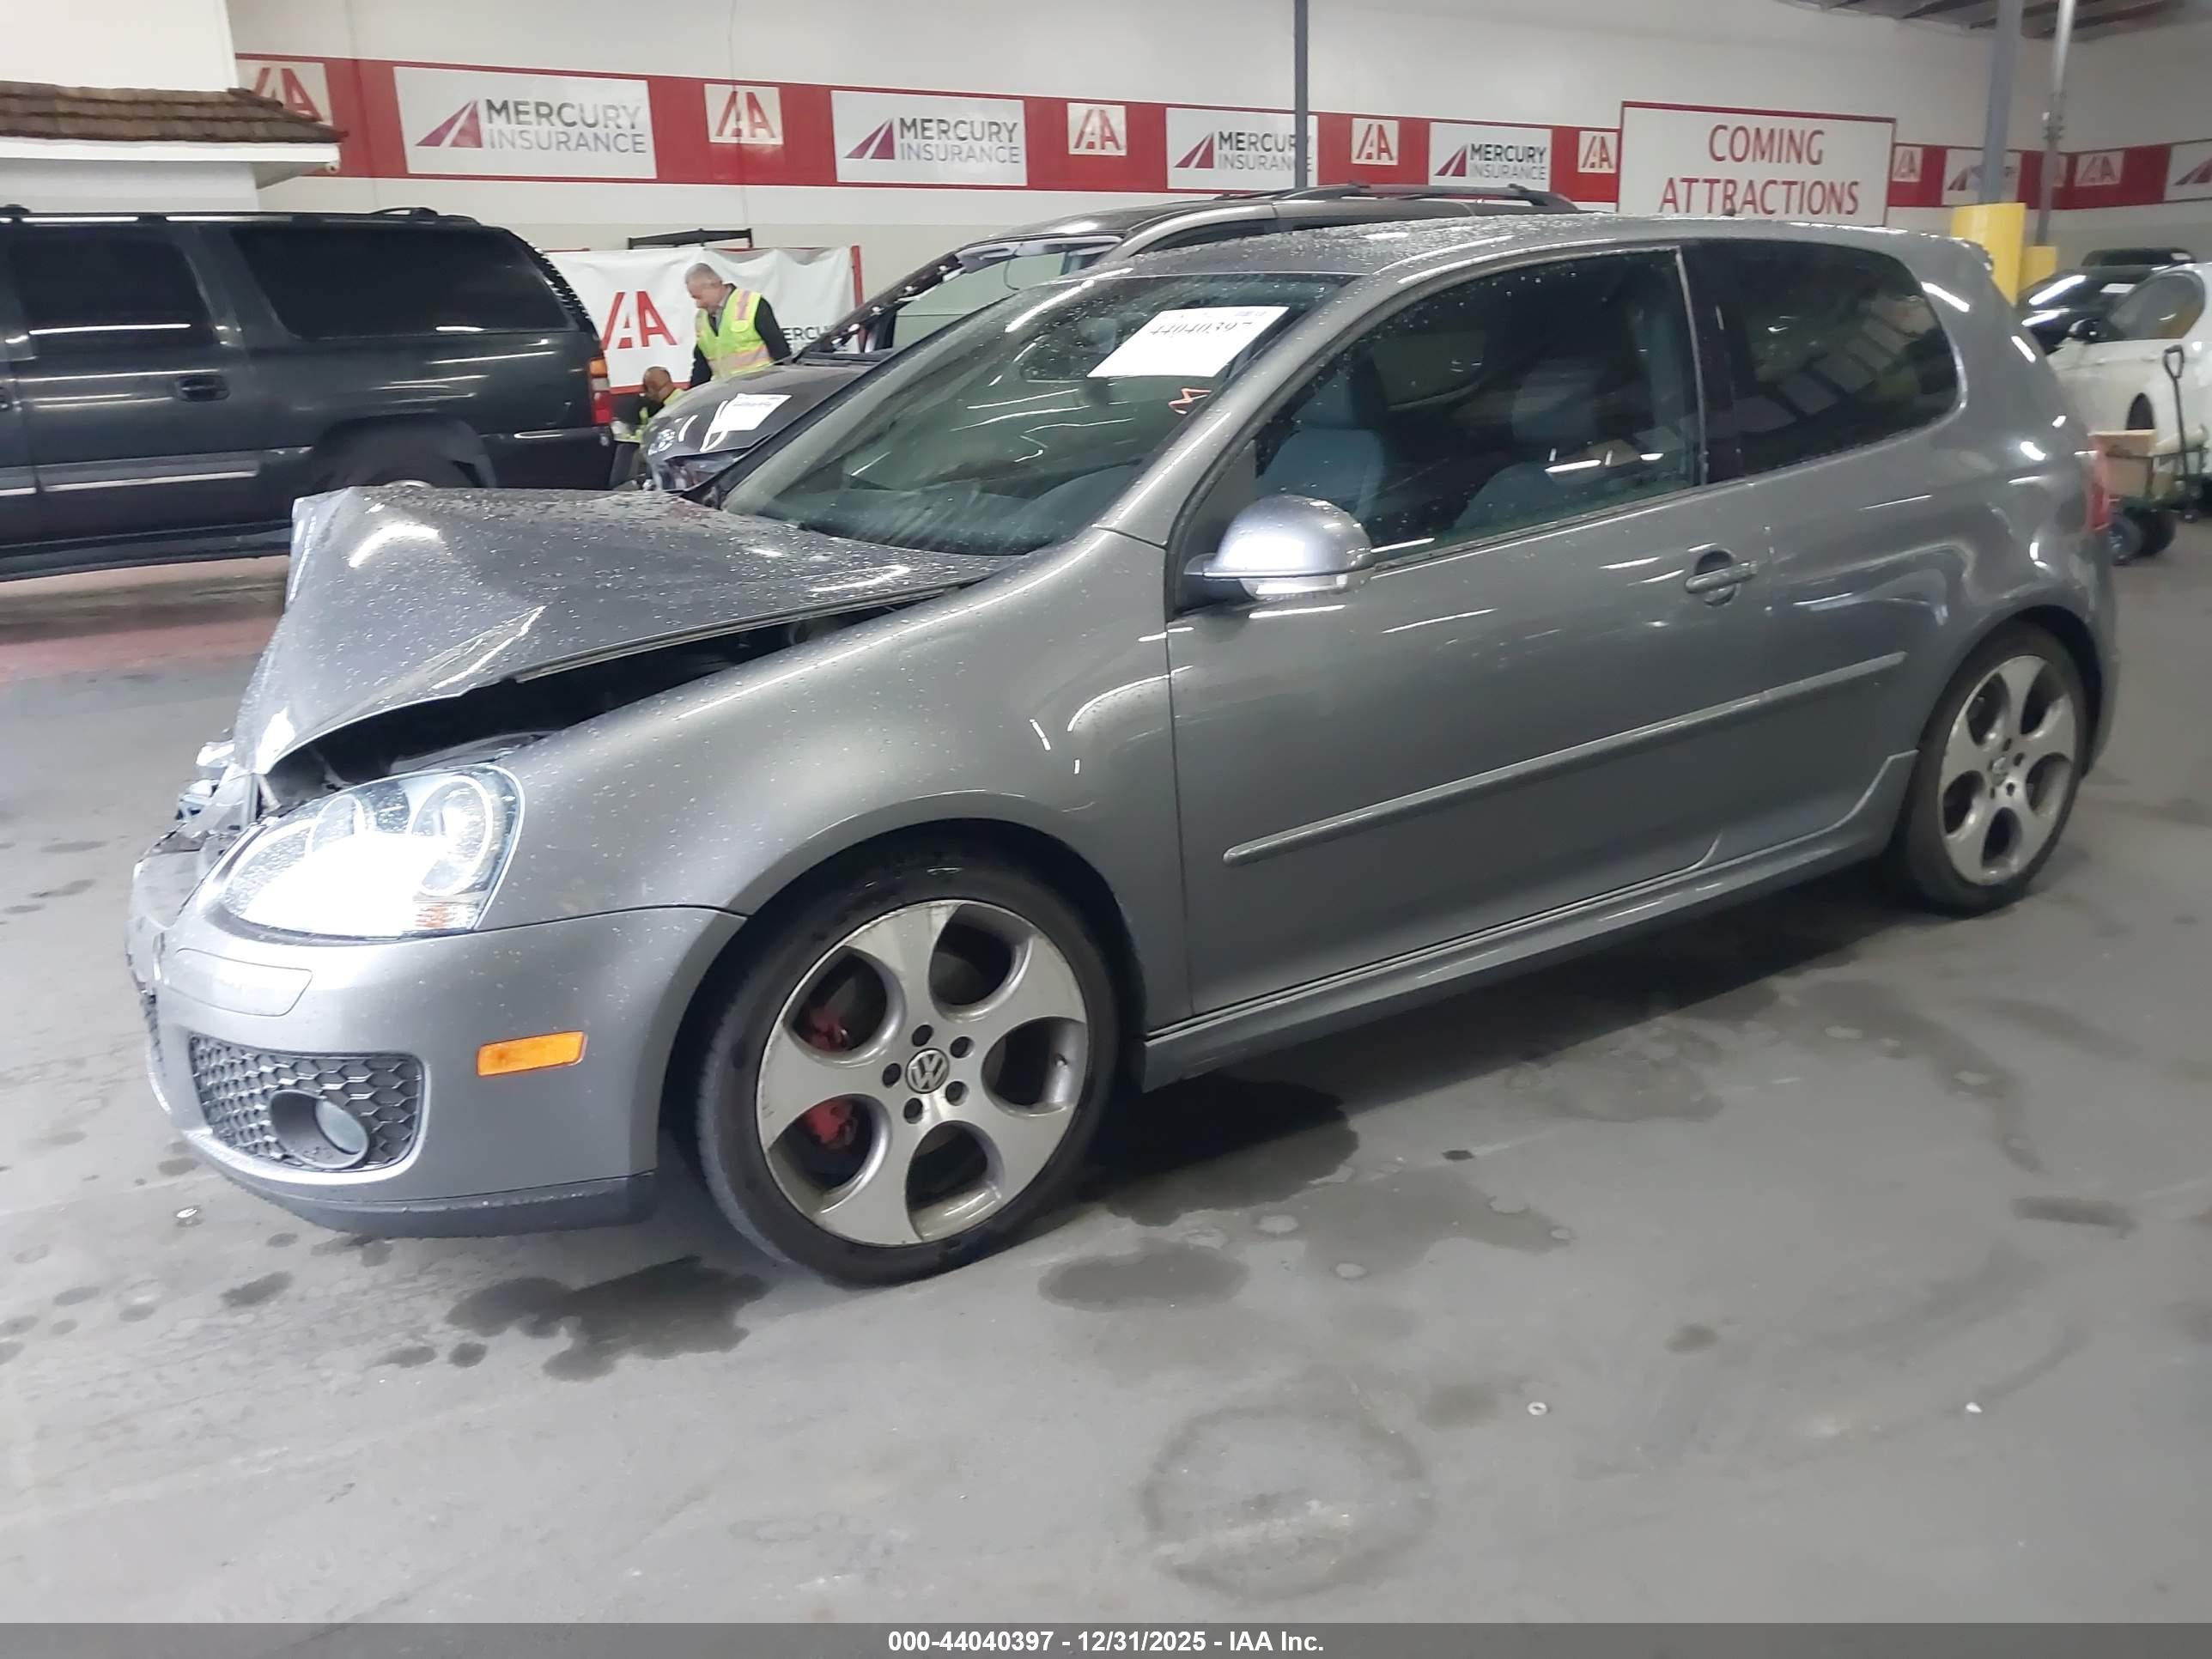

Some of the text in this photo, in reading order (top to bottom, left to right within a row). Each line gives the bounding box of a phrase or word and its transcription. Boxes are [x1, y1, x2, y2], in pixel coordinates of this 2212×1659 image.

[486, 99, 640, 129] MERCURY
[489, 129, 646, 153] INSURANCE
[900, 118, 1018, 143] MERCURY
[1218, 131, 1311, 152] MERCUR
[901, 143, 1019, 163] INSURANCE
[1470, 143, 1546, 163] MERCURY
[1709, 125, 1824, 165] COMING
[1219, 154, 1312, 171] INSURANE
[1470, 163, 1546, 179] INSURANCE
[1659, 177, 1858, 215] ATTRACTIONS
